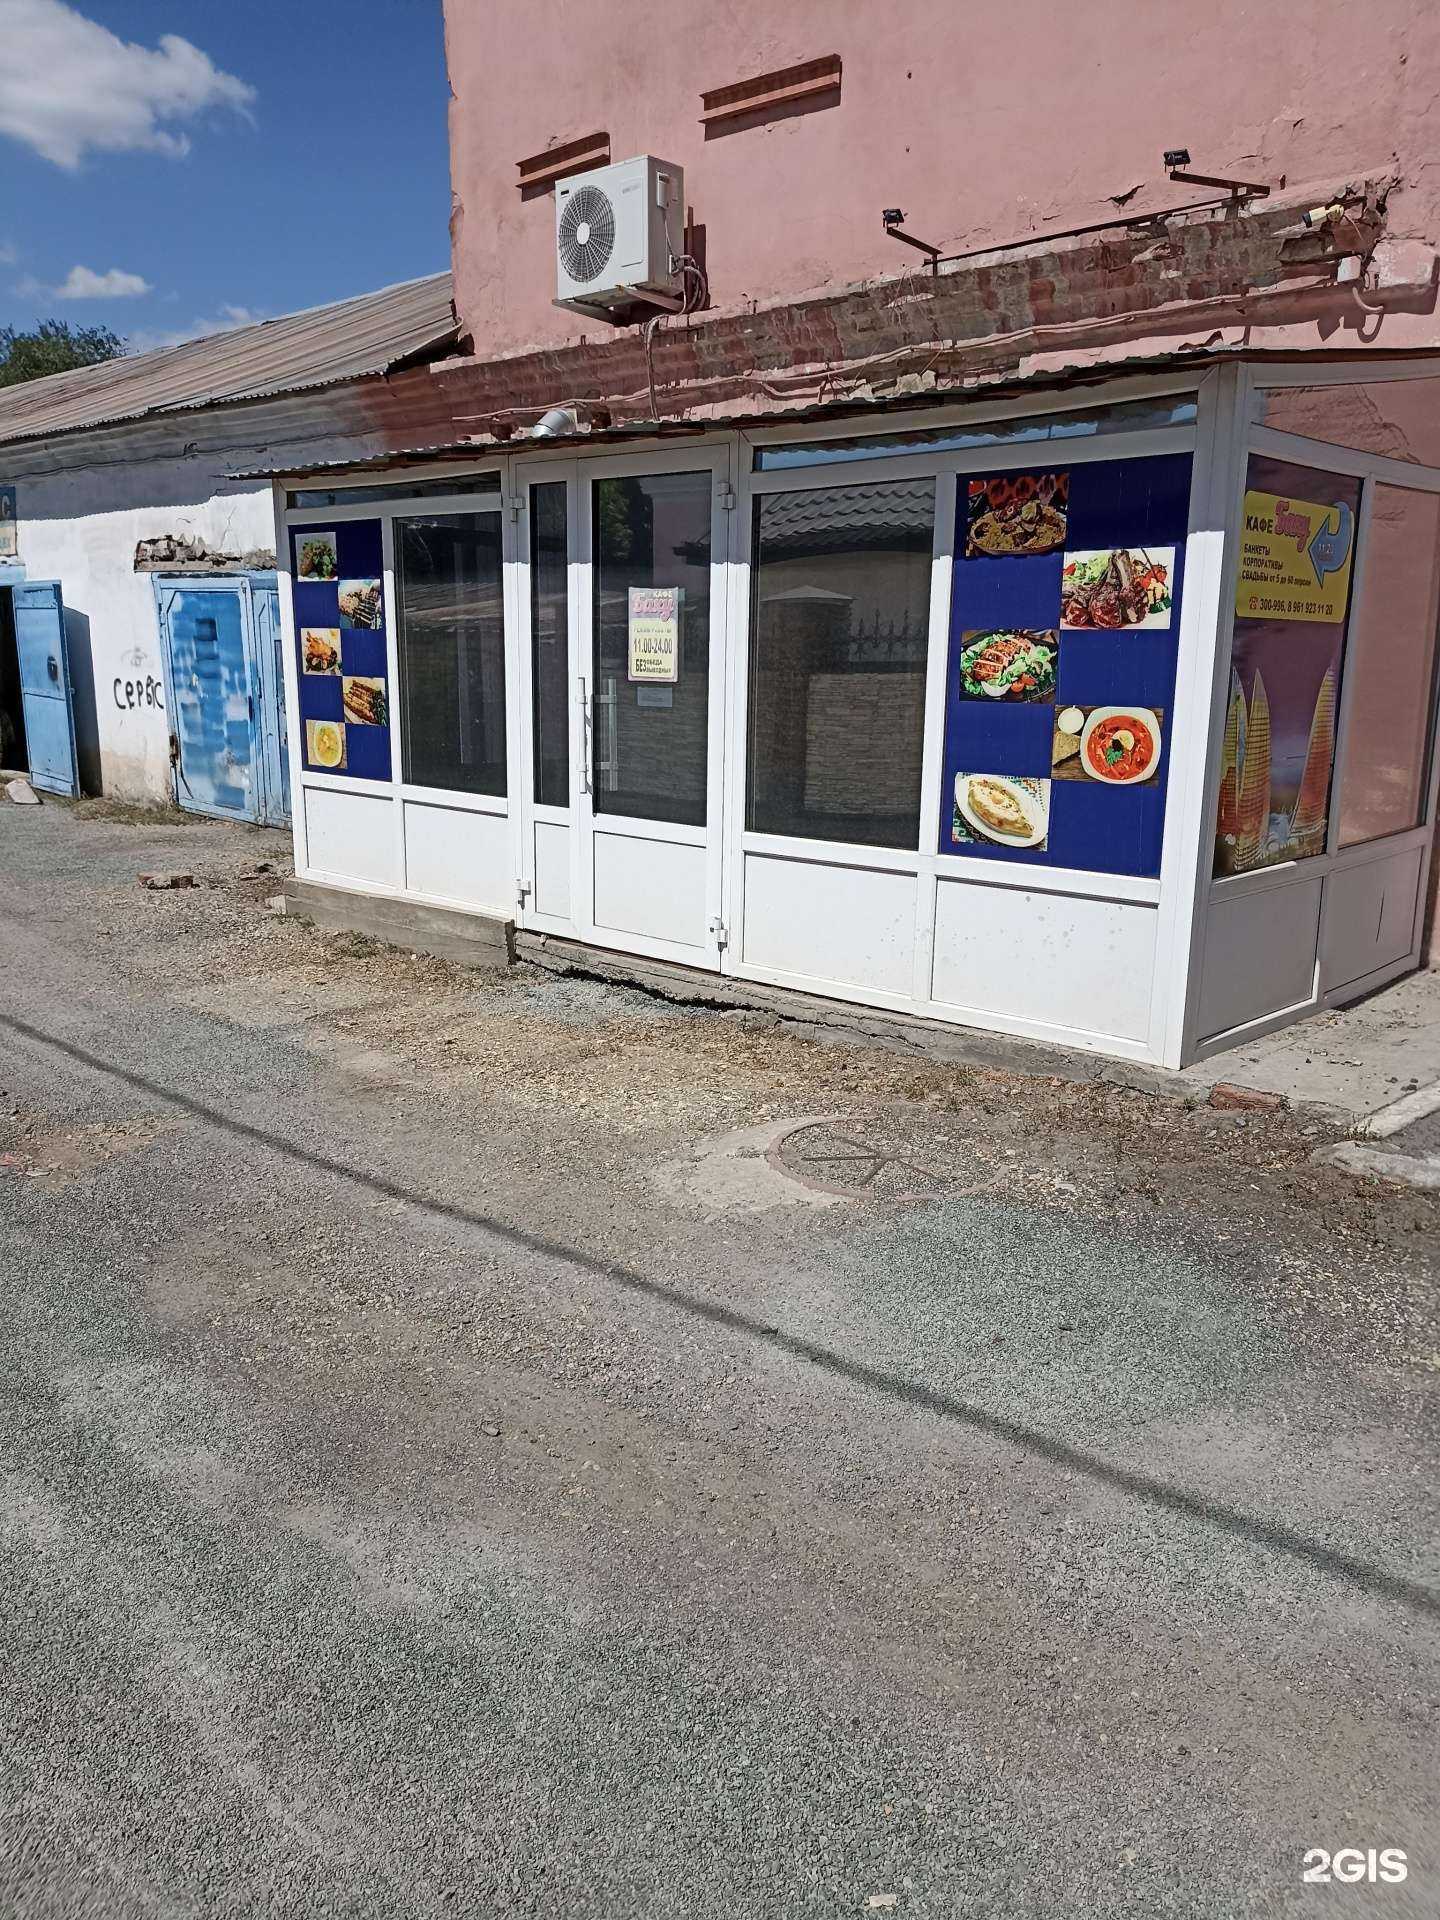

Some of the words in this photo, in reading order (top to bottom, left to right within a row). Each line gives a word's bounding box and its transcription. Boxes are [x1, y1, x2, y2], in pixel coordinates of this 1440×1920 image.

[1246, 515, 1274, 534] КАФЕ
[1243, 543, 1271, 556] БАНКЕТЫ
[1242, 557, 1283, 571] КОРПОРАТИВЫ
[1241, 569, 1269, 583] СВАДЬБЫ
[1275, 573, 1280, 583] 5
[1287, 600, 1292, 612] 8
[1317, 603, 1325, 615] 11
[634, 637, 673, 654] 11.00-24.00
[635, 658, 646, 672] БЕЗ
